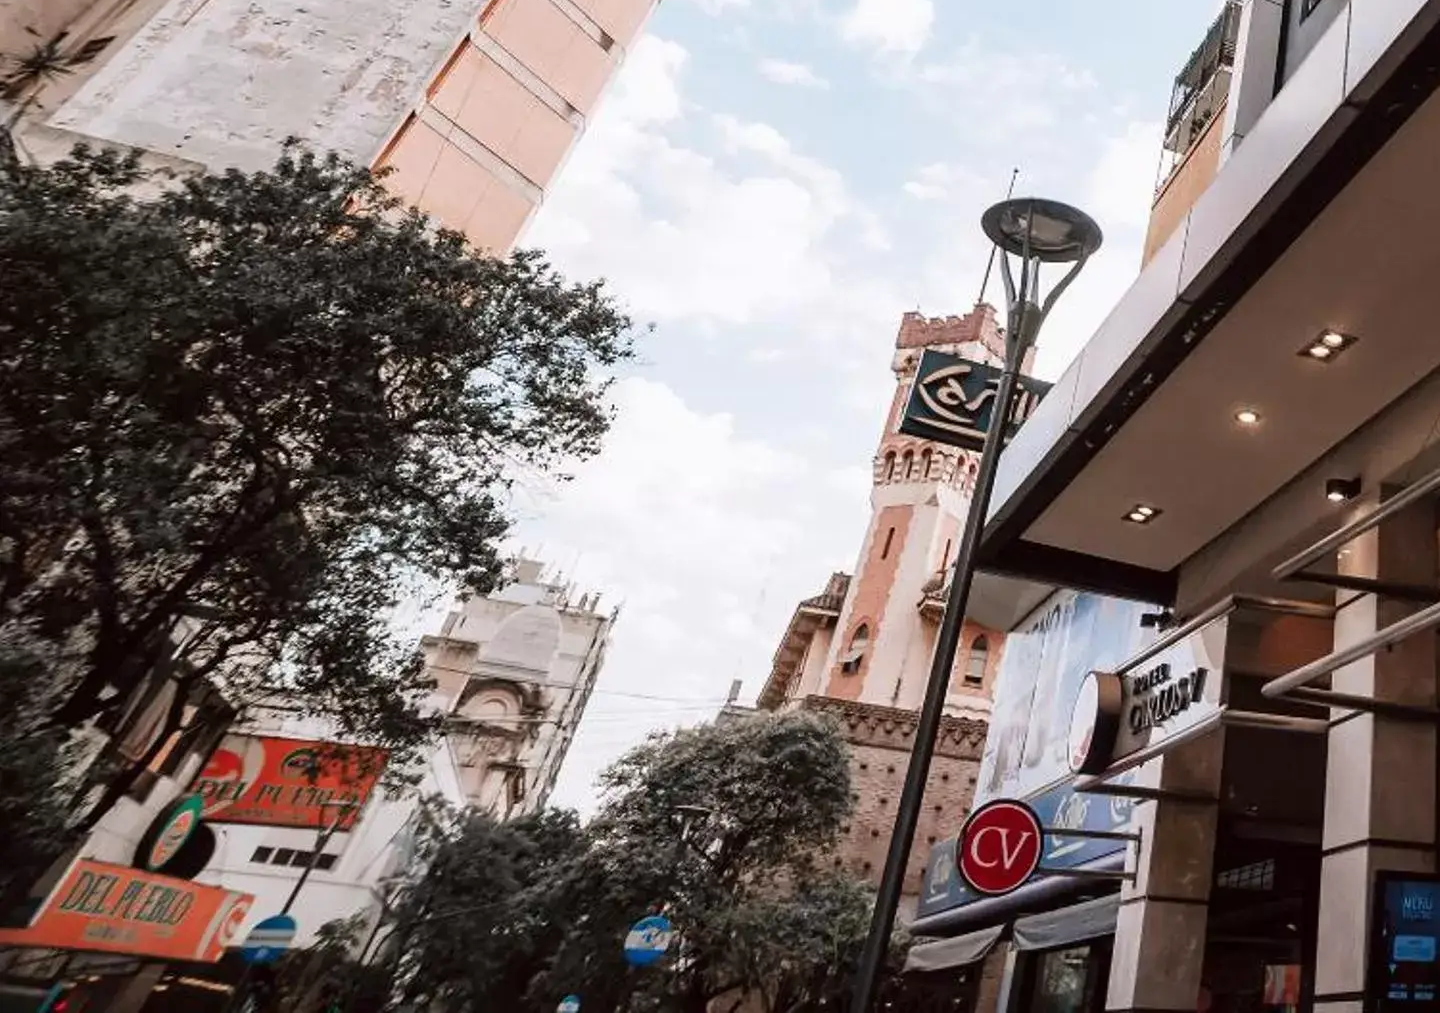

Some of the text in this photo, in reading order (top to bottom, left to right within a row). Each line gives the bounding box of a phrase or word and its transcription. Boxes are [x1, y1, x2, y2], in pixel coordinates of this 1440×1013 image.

[971, 826, 1033, 870] CV
[60, 870, 195, 925] DEL PUEBLO
